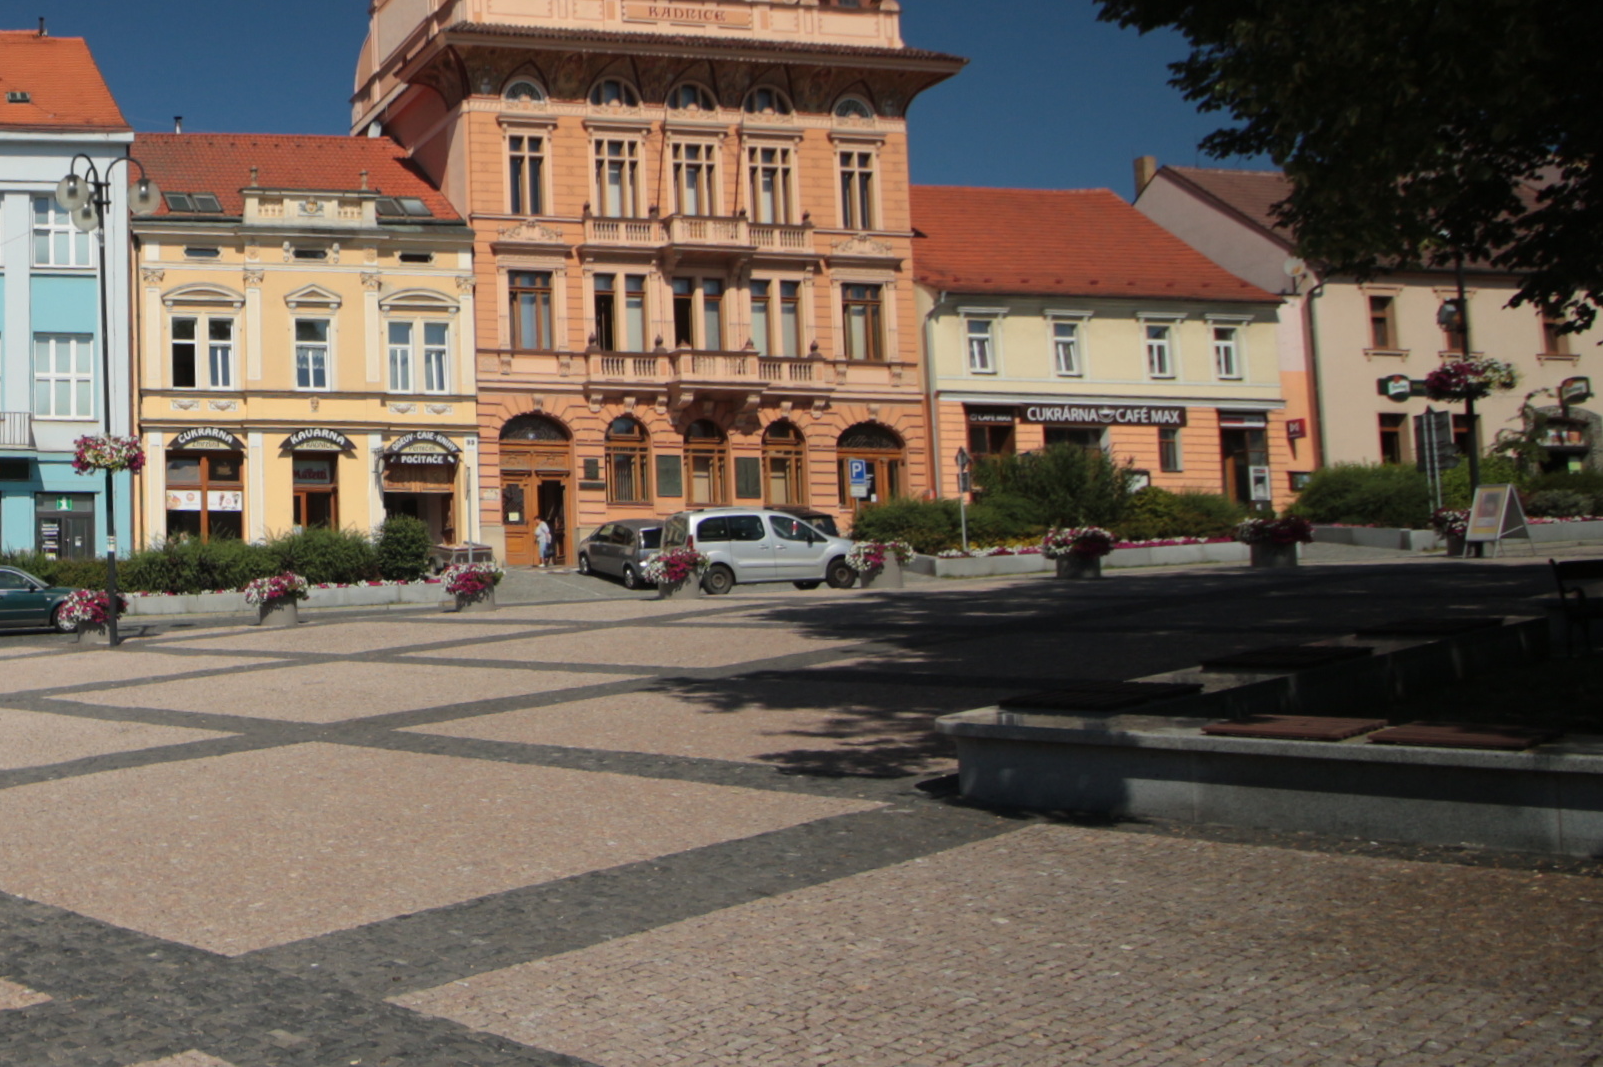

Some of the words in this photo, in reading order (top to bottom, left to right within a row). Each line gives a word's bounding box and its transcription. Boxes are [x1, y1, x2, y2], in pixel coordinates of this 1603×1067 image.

[648, 6, 726, 21] RADNICE
[1027, 406, 1098, 422] CUKRÁRNA
[1116, 407, 1148, 423] CAFÉ
[1151, 410, 1179, 423] MAX
[851, 462, 862, 478] P
